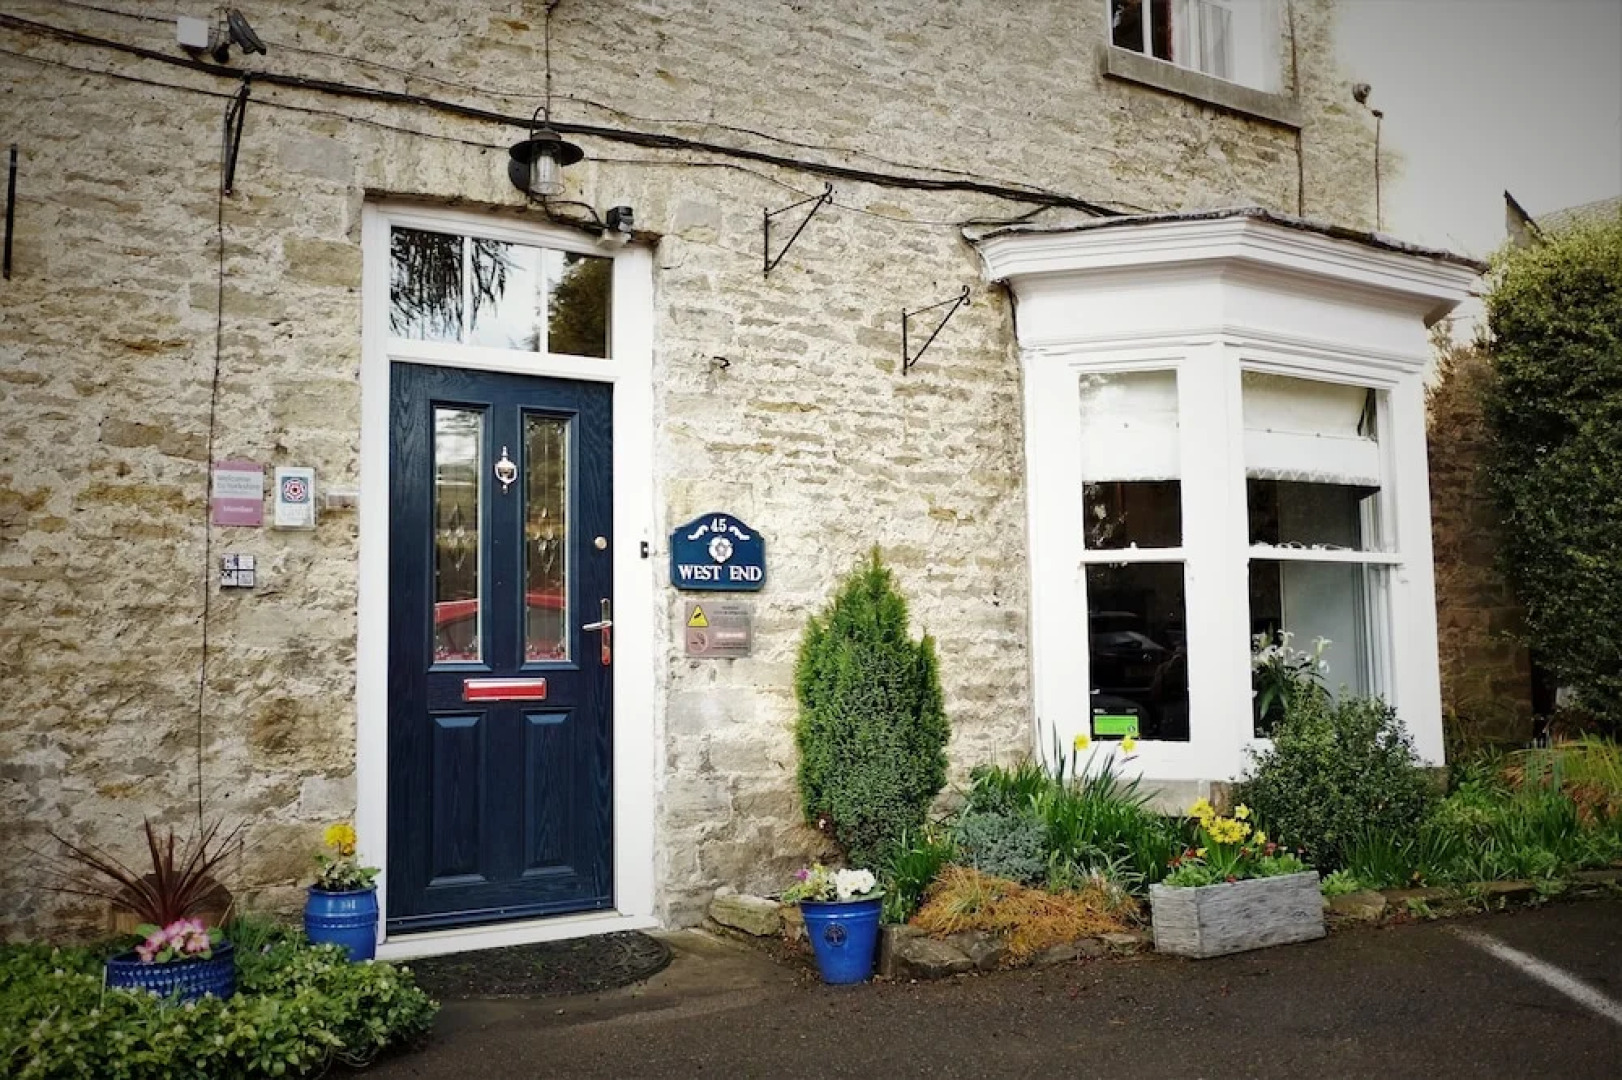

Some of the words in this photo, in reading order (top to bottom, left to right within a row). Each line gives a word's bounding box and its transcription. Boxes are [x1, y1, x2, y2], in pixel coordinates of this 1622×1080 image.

[710, 518, 727, 533] 45
[678, 565, 722, 580] WEST
[729, 565, 762, 581] END
